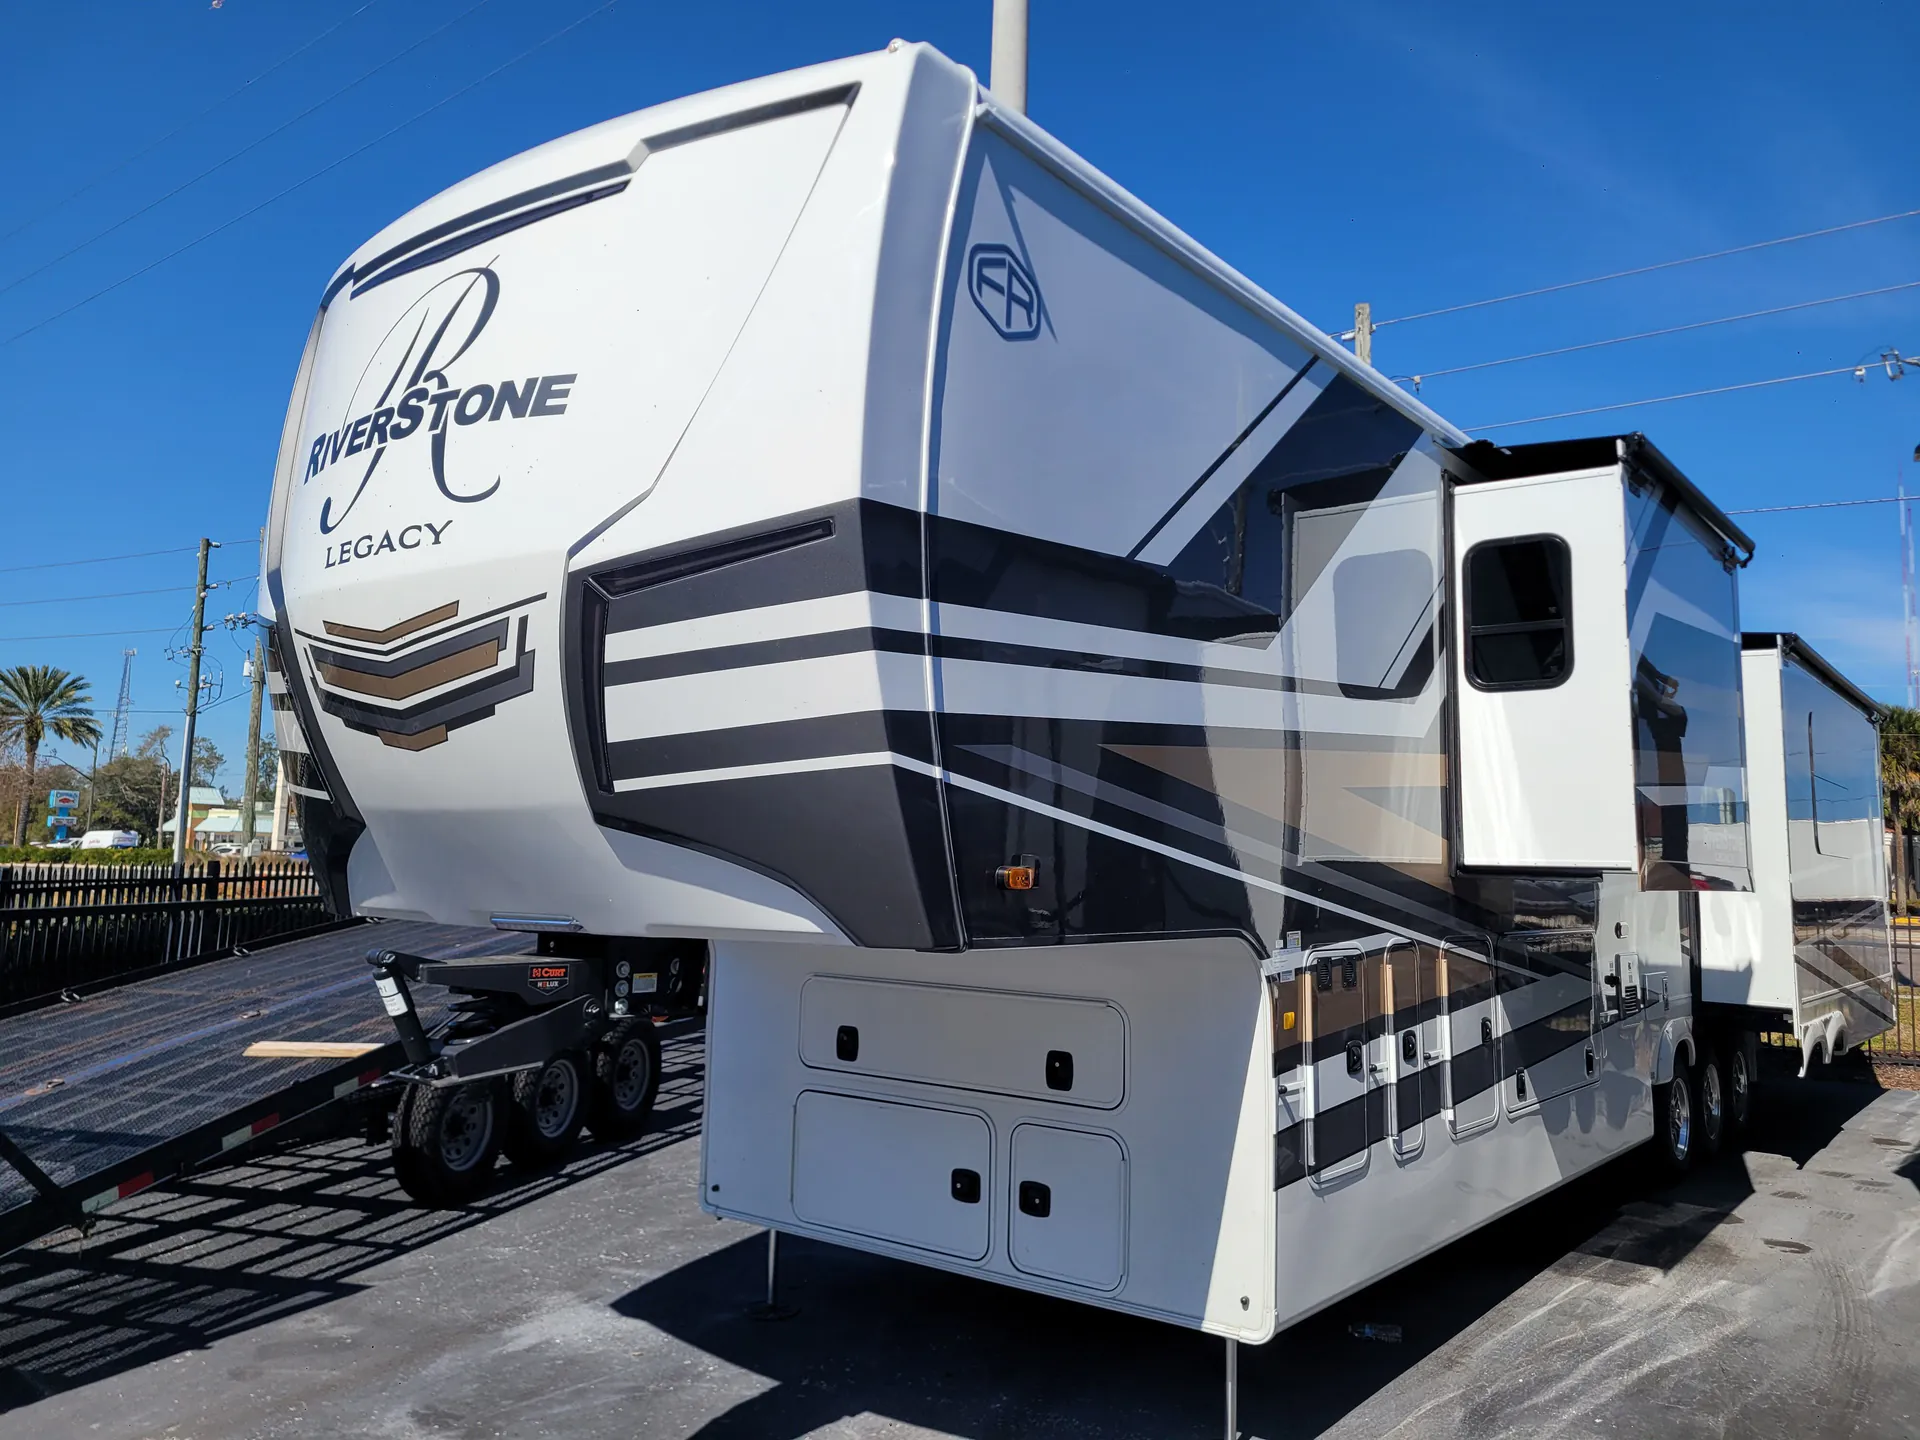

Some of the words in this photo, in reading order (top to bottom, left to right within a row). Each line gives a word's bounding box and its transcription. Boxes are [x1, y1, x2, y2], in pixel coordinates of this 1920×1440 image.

[303, 372, 578, 486] RIVERSTONE
[325, 519, 454, 569] LEGACY
[542, 968, 565, 977] CURT
